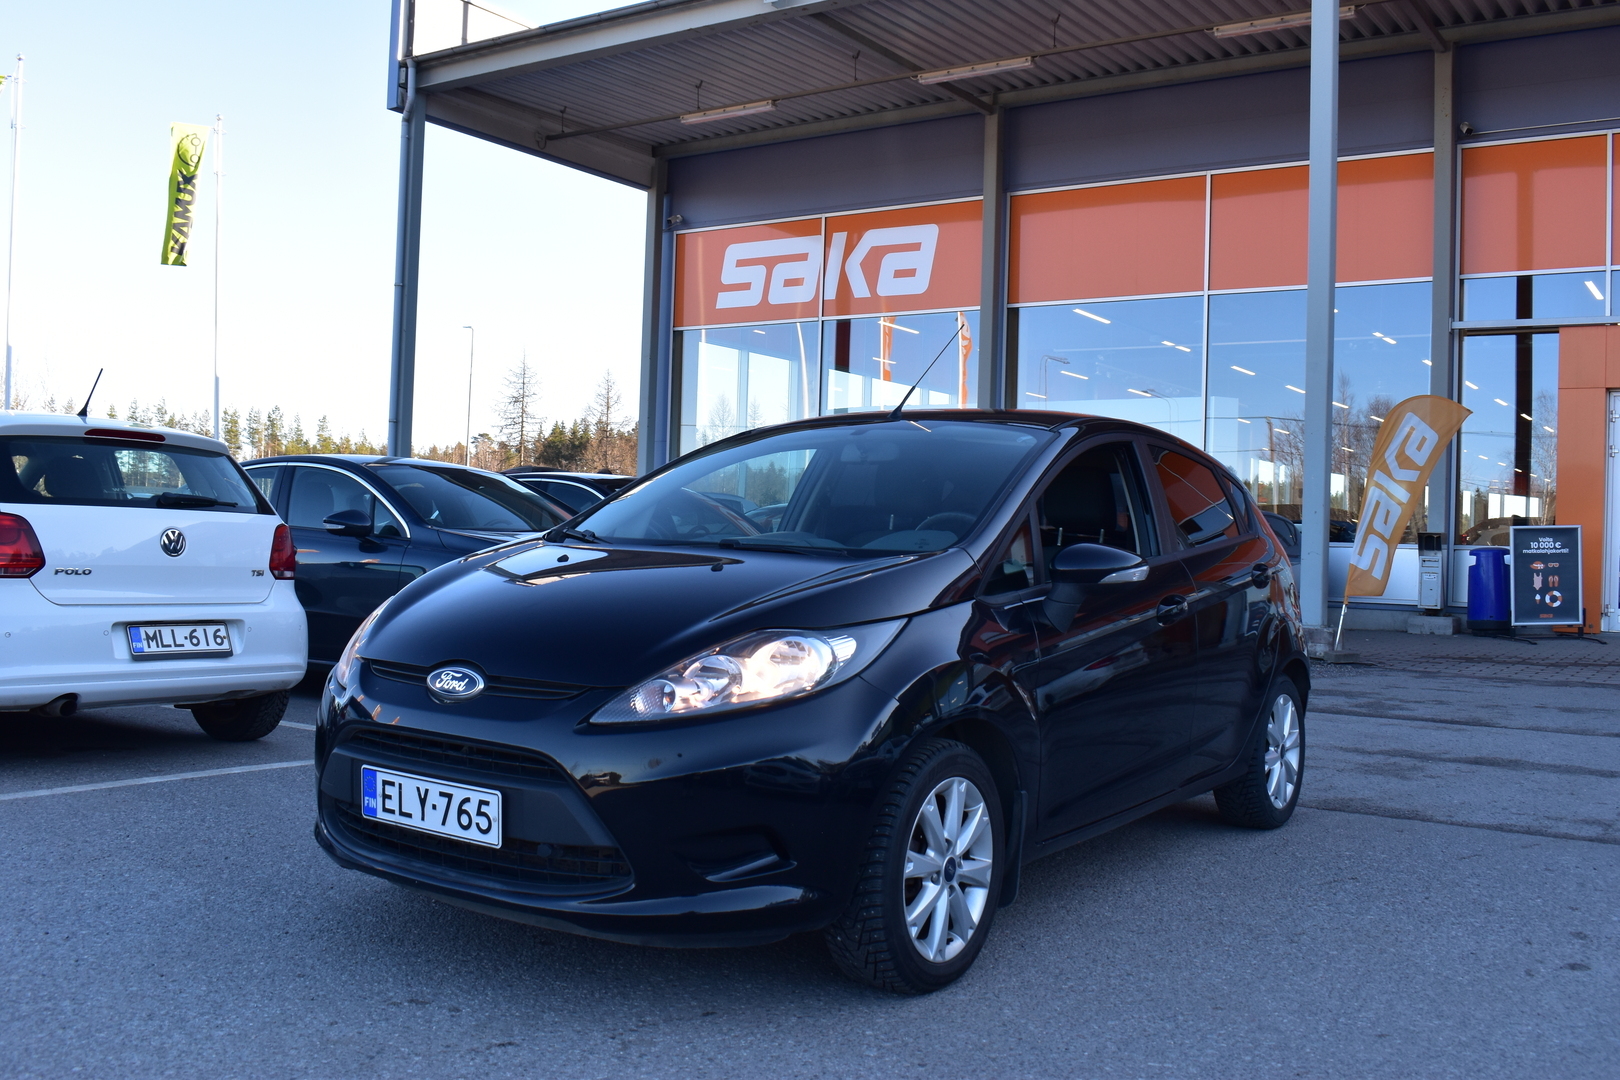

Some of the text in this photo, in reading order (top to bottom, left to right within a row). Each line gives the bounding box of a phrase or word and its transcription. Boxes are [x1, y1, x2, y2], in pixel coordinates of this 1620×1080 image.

[170, 169, 199, 256] KAMUX
[54, 567, 92, 576] POLO
[251, 569, 265, 577] TSI
[132, 641, 143, 649] FIN
[144, 628, 225, 649] MLL-616
[435, 670, 469, 692] Ford
[364, 796, 377, 809] FIN
[381, 778, 492, 835] ELY-765
